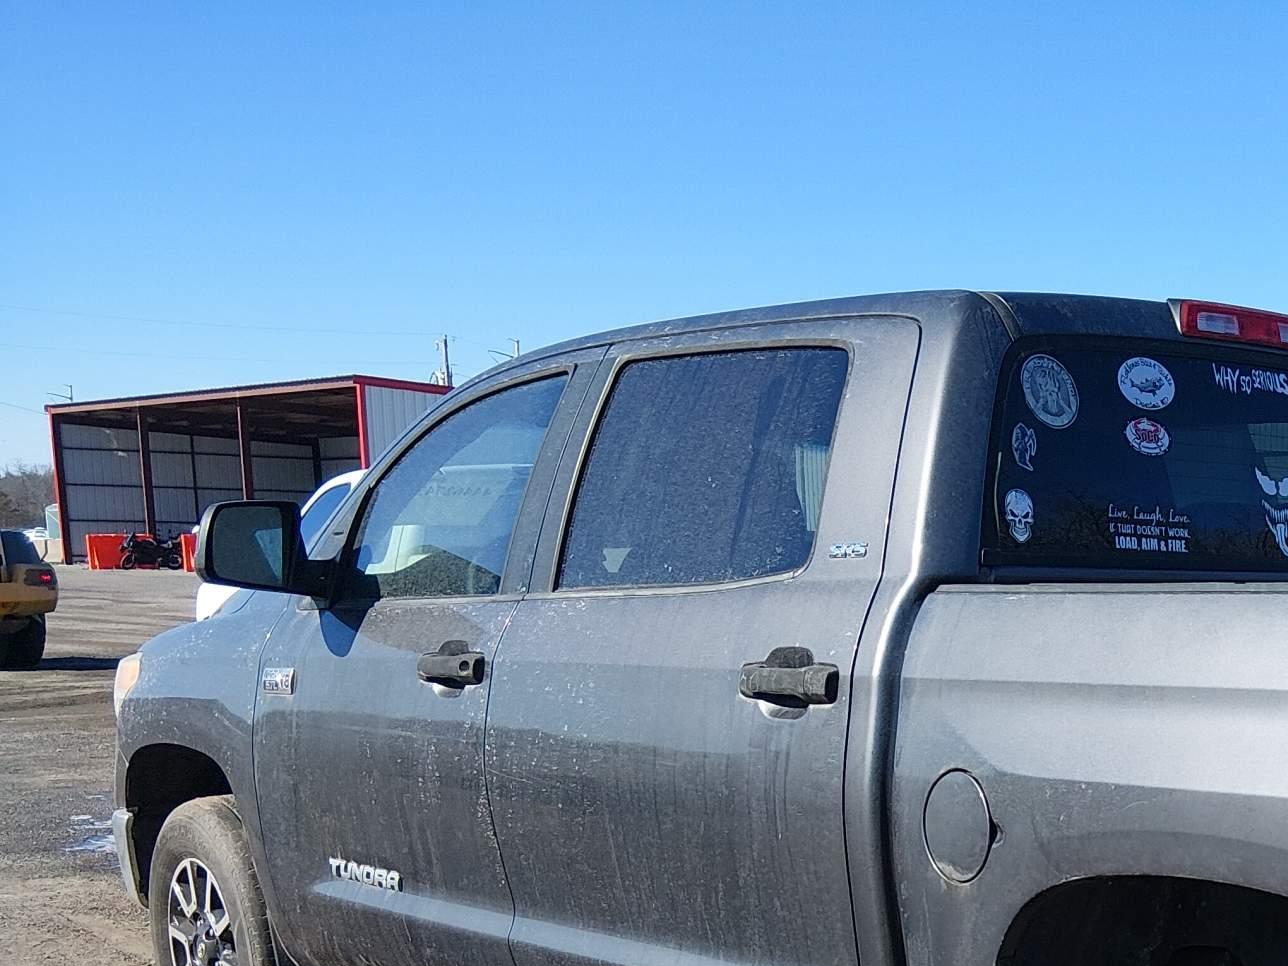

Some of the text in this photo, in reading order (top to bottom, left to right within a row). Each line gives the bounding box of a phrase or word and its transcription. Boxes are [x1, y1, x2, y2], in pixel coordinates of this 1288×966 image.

[1212, 362, 1240, 394] WHY
[1240, 375, 1252, 395] SO
[1117, 523, 1135, 534] THAT
[1141, 537, 1159, 551] AIM
[1160, 540, 1167, 552] &
[328, 856, 400, 892] TUNDRA
